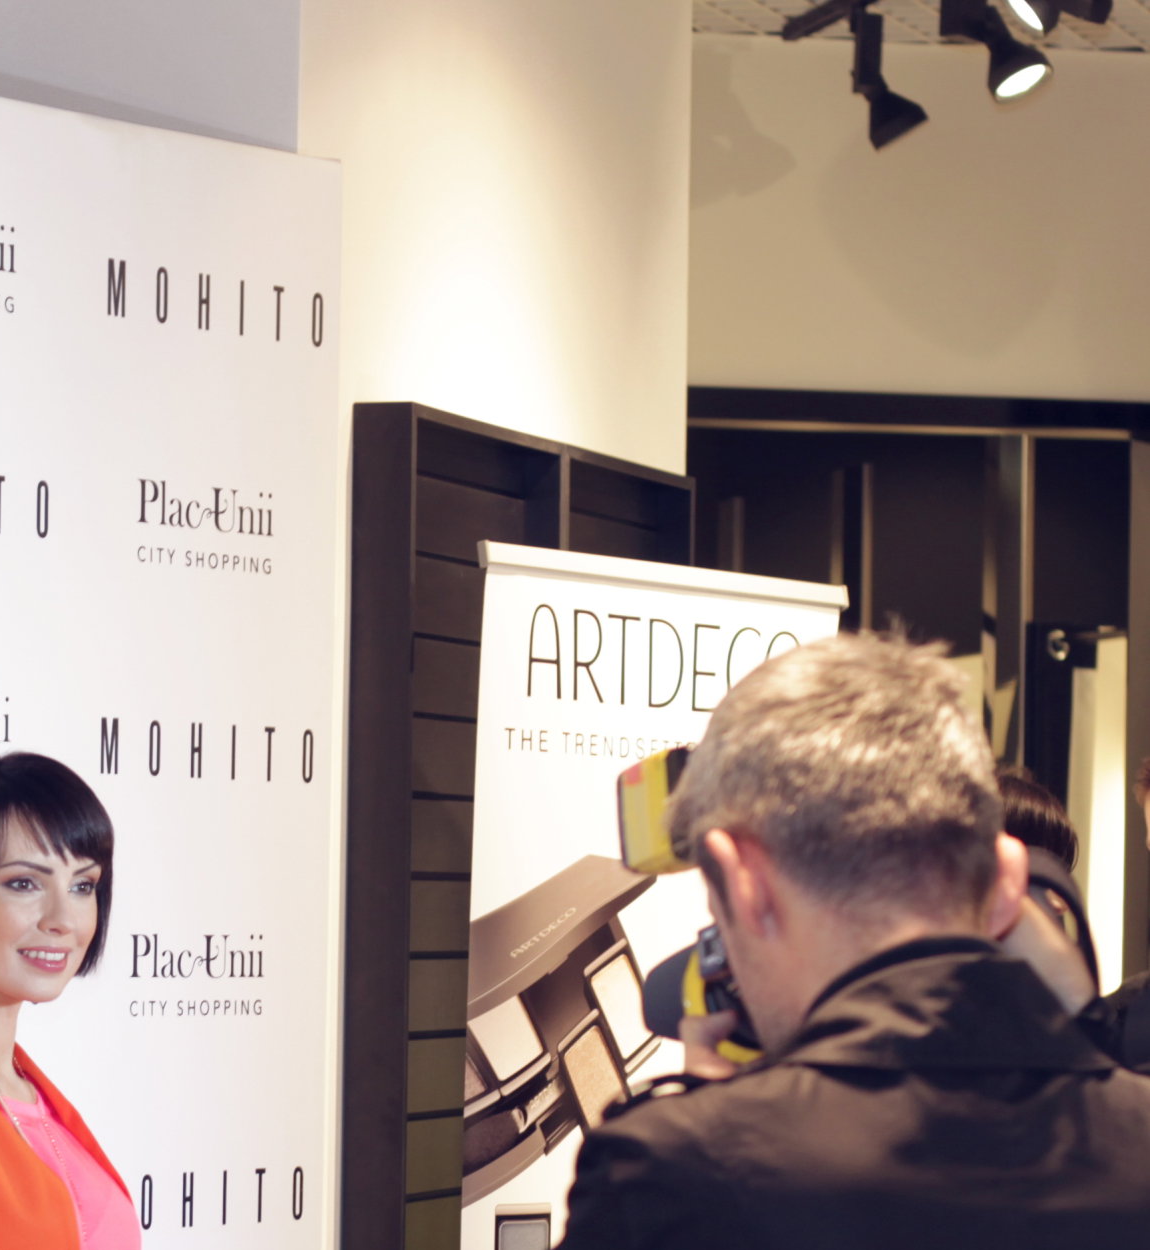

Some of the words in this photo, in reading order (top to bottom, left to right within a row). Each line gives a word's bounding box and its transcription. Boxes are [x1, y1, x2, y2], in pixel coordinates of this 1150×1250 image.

[107, 258, 323, 347] MOHITO
[137, 546, 175, 564] CITY
[185, 550, 271, 575] SHOPPING
[527, 603, 800, 712] ARTDEC
[101, 717, 313, 783] MOHITO
[504, 727, 548, 752] THE
[509, 906, 577, 959] ARTDECO
[130, 1001, 167, 1017] CITY
[177, 999, 262, 1016] SHOPPING
[141, 1166, 303, 1230] OHITO
